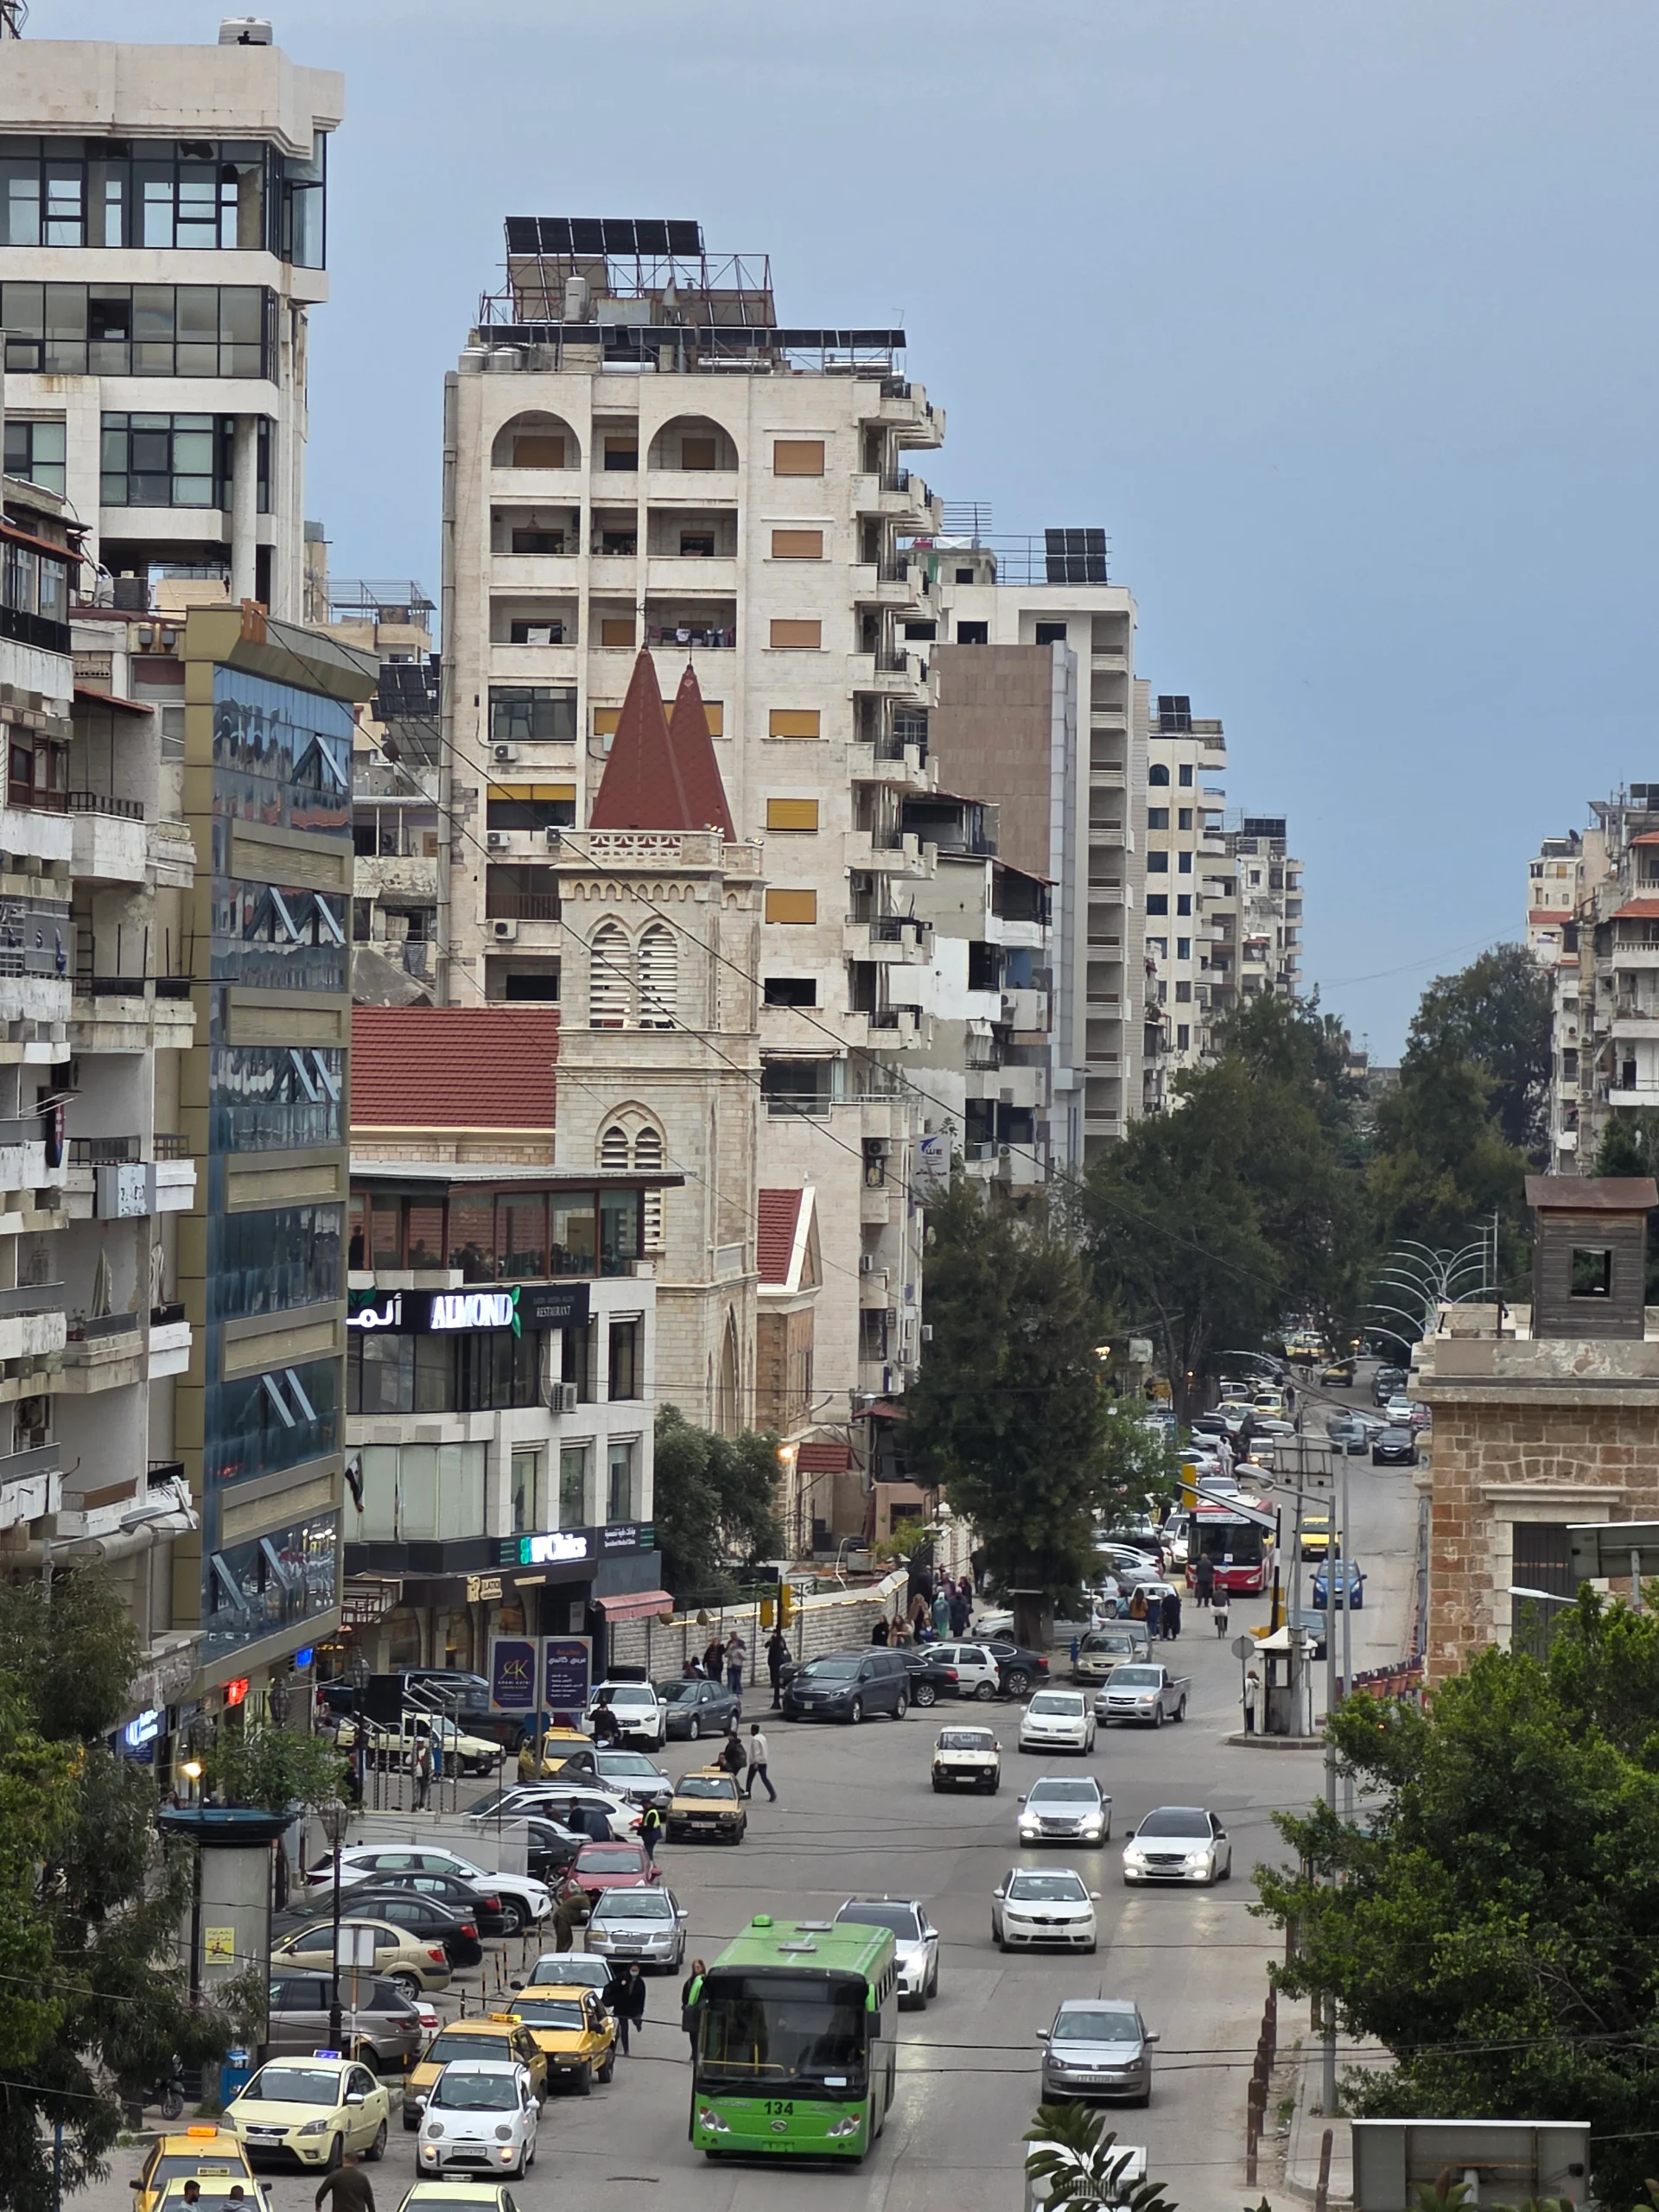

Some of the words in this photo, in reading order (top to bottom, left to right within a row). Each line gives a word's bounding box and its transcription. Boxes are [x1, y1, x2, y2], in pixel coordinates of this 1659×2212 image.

[430, 1293, 513, 1330] ALMOND
[536, 1306, 571, 1318] RESTAURANT
[764, 2101, 794, 2116] 134
